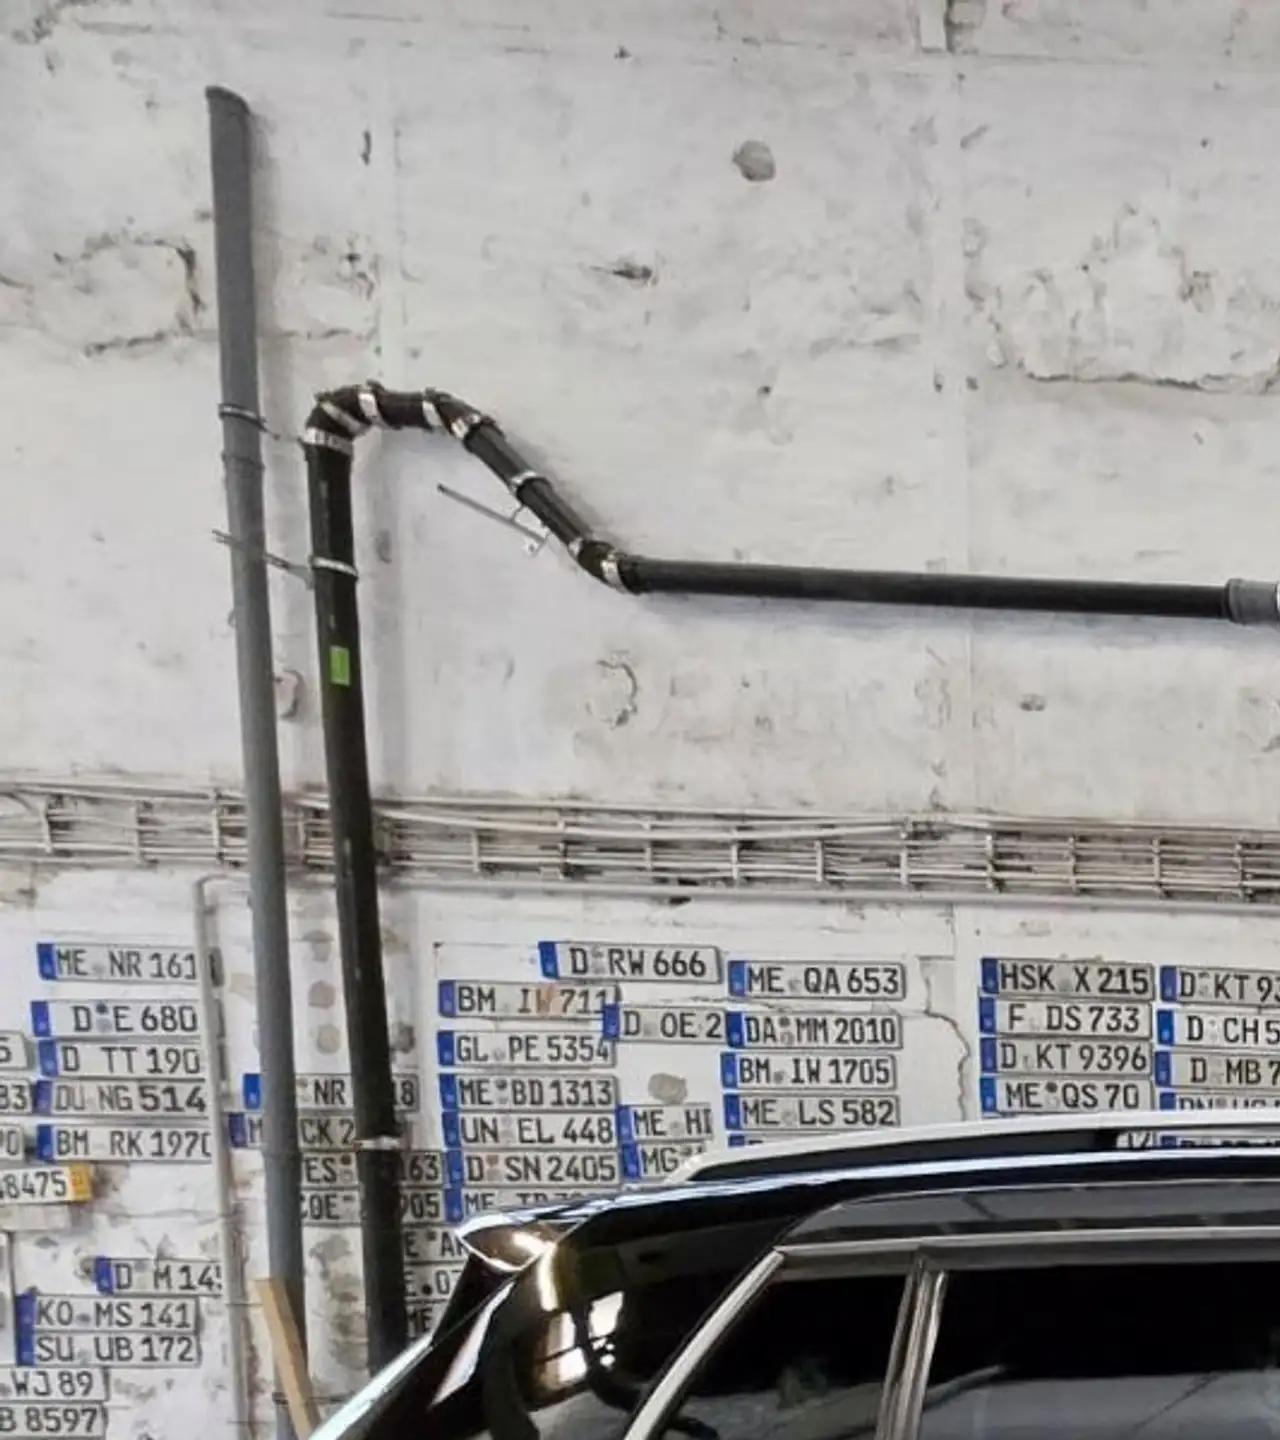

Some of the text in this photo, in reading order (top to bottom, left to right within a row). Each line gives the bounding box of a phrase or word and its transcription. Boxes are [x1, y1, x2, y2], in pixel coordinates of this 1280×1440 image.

[108, 950, 141, 978] NR
[150, 952, 197, 981] 161
[570, 947, 706, 977] D RW 666
[748, 966, 899, 995] ME QA 653
[1000, 962, 1149, 995] HSK X 215
[72, 1005, 197, 1032] D E 680
[745, 1016, 896, 1045] DA MM 2010
[1008, 1003, 1140, 1033] F DS 733
[1187, 1015, 1204, 1042] D
[1223, 1017, 1260, 1045] CH
[62, 1045, 201, 1074] D TT 190
[739, 1058, 890, 1085] BM IW 1705
[1001, 1044, 1148, 1072] D KT 9396
[1190, 1057, 1206, 1083] D
[1225, 1059, 1262, 1085] MB
[458, 1079, 613, 1106] ME BD 1313
[1005, 1081, 1140, 1109] ME QS 70
[742, 1100, 895, 1127] ME LS 582
[461, 1116, 613, 1144] UN EL 448
[467, 1155, 616, 1182] D SN 2405
[36, 1301, 191, 1328] KO MS 141
[36, 1337, 283, 1363] SU UB 172
